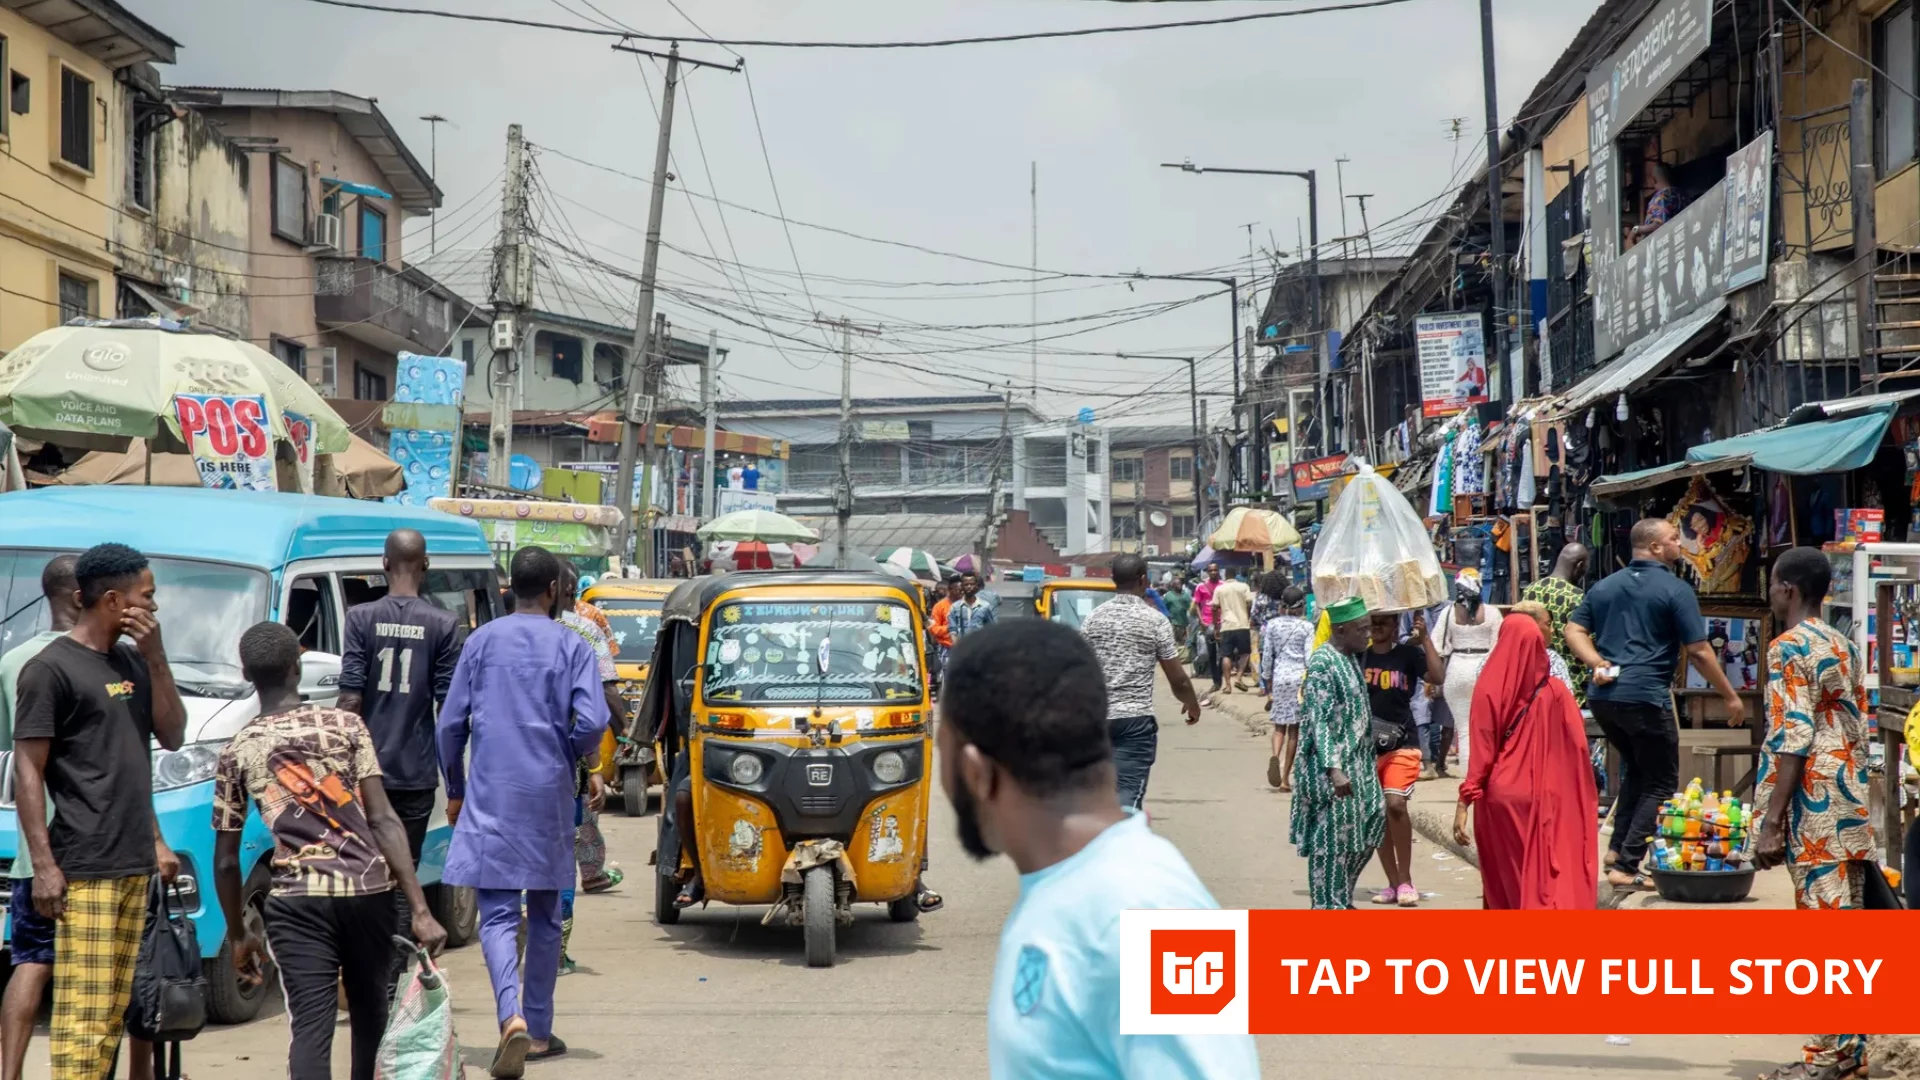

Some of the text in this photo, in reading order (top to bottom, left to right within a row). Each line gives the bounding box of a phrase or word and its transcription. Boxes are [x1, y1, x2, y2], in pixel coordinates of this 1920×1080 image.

[1591, 114, 1609, 153] LIVE
[90, 347, 125, 363] glo
[61, 400, 117, 415] VOICE AND
[56, 412, 122, 428] DATA PLANS
[175, 396, 267, 459] POS
[201, 462, 250, 473] IS HERE
[375, 622, 425, 640] NOVEMBER
[377, 647, 413, 694] 11
[811, 771, 829, 781] RE
